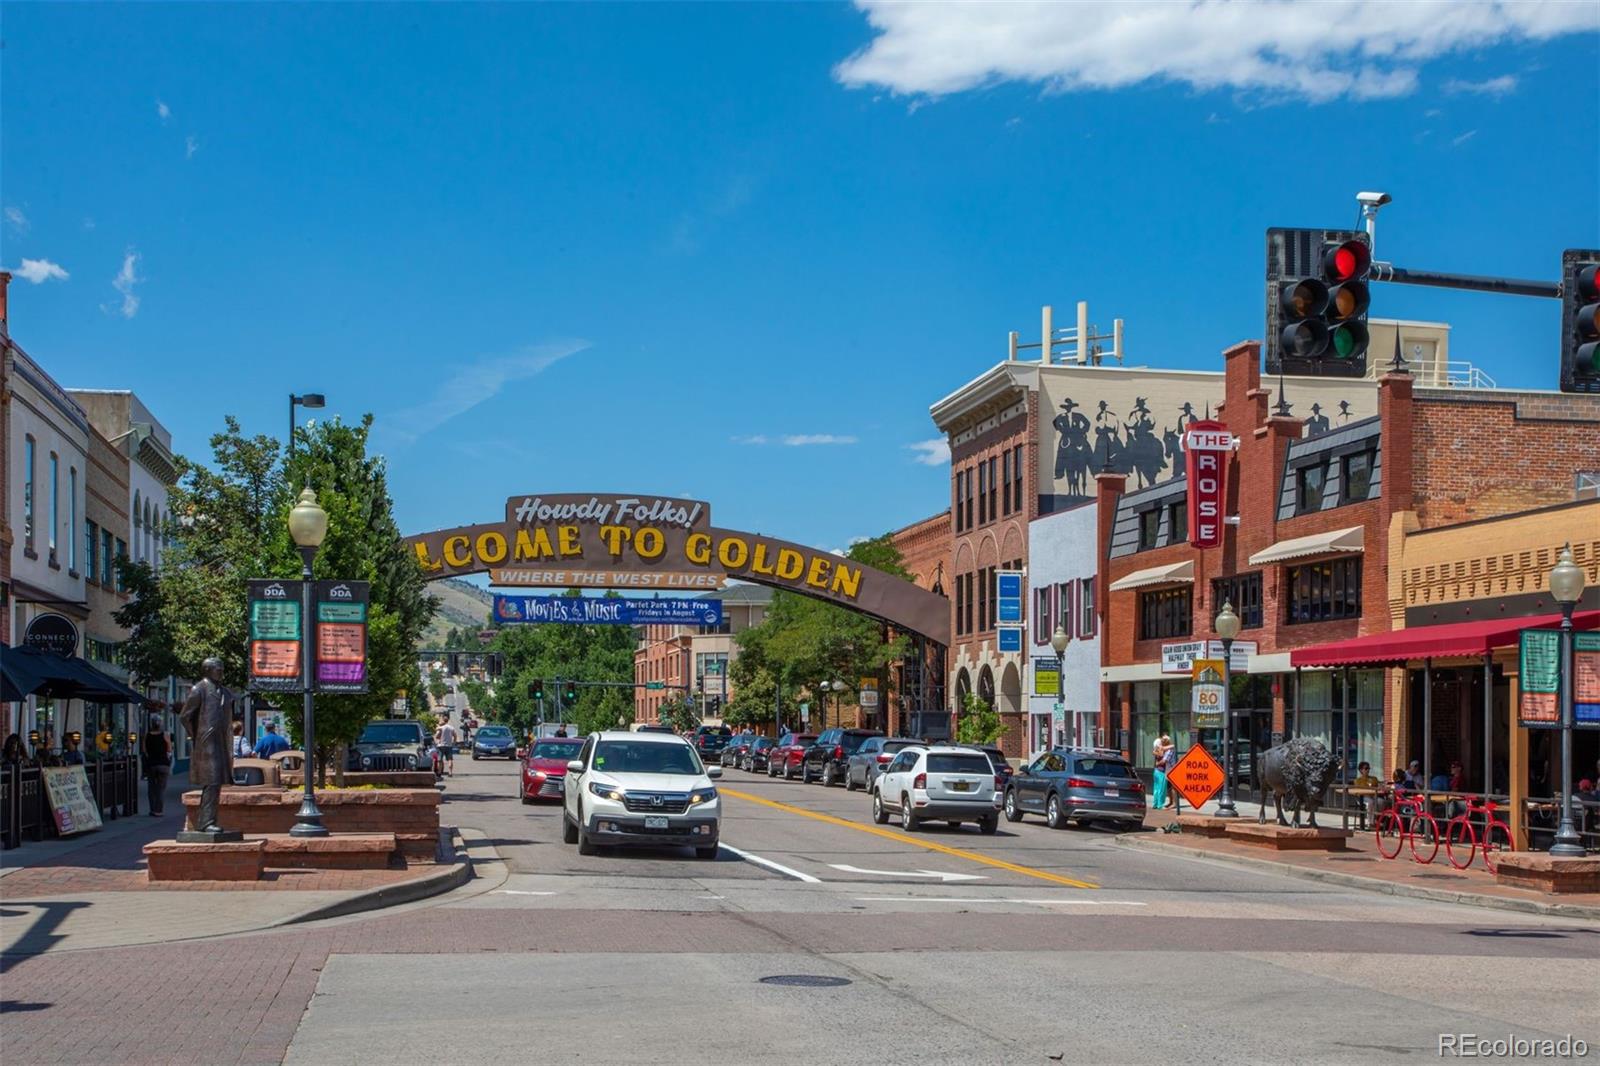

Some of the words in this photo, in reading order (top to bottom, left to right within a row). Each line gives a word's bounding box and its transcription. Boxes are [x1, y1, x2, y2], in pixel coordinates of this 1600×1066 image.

[1192, 434, 1229, 446] THE
[1200, 455, 1217, 540] ROSE
[515, 497, 613, 526] Howdy
[614, 498, 702, 529] Folks!
[415, 526, 583, 572] LCOME
[600, 525, 665, 558] TO
[685, 533, 862, 597] GOLDEN
[500, 571, 565, 584] WHERE
[570, 572, 611, 585] THE
[612, 573, 664, 585] WEST
[668, 574, 718, 586] LIVES
[264, 588, 286, 596] DDA
[330, 590, 352, 598] DDA
[650, 601, 668, 609] Park
[692, 602, 710, 610] Free
[638, 609, 662, 617] Fridays
[671, 609, 696, 617] August
[1199, 692, 1218, 705] 80
[1186, 761, 1209, 769] ROAD
[1186, 773, 1209, 781] WORK
[1184, 784, 1212, 792] AHEAD
